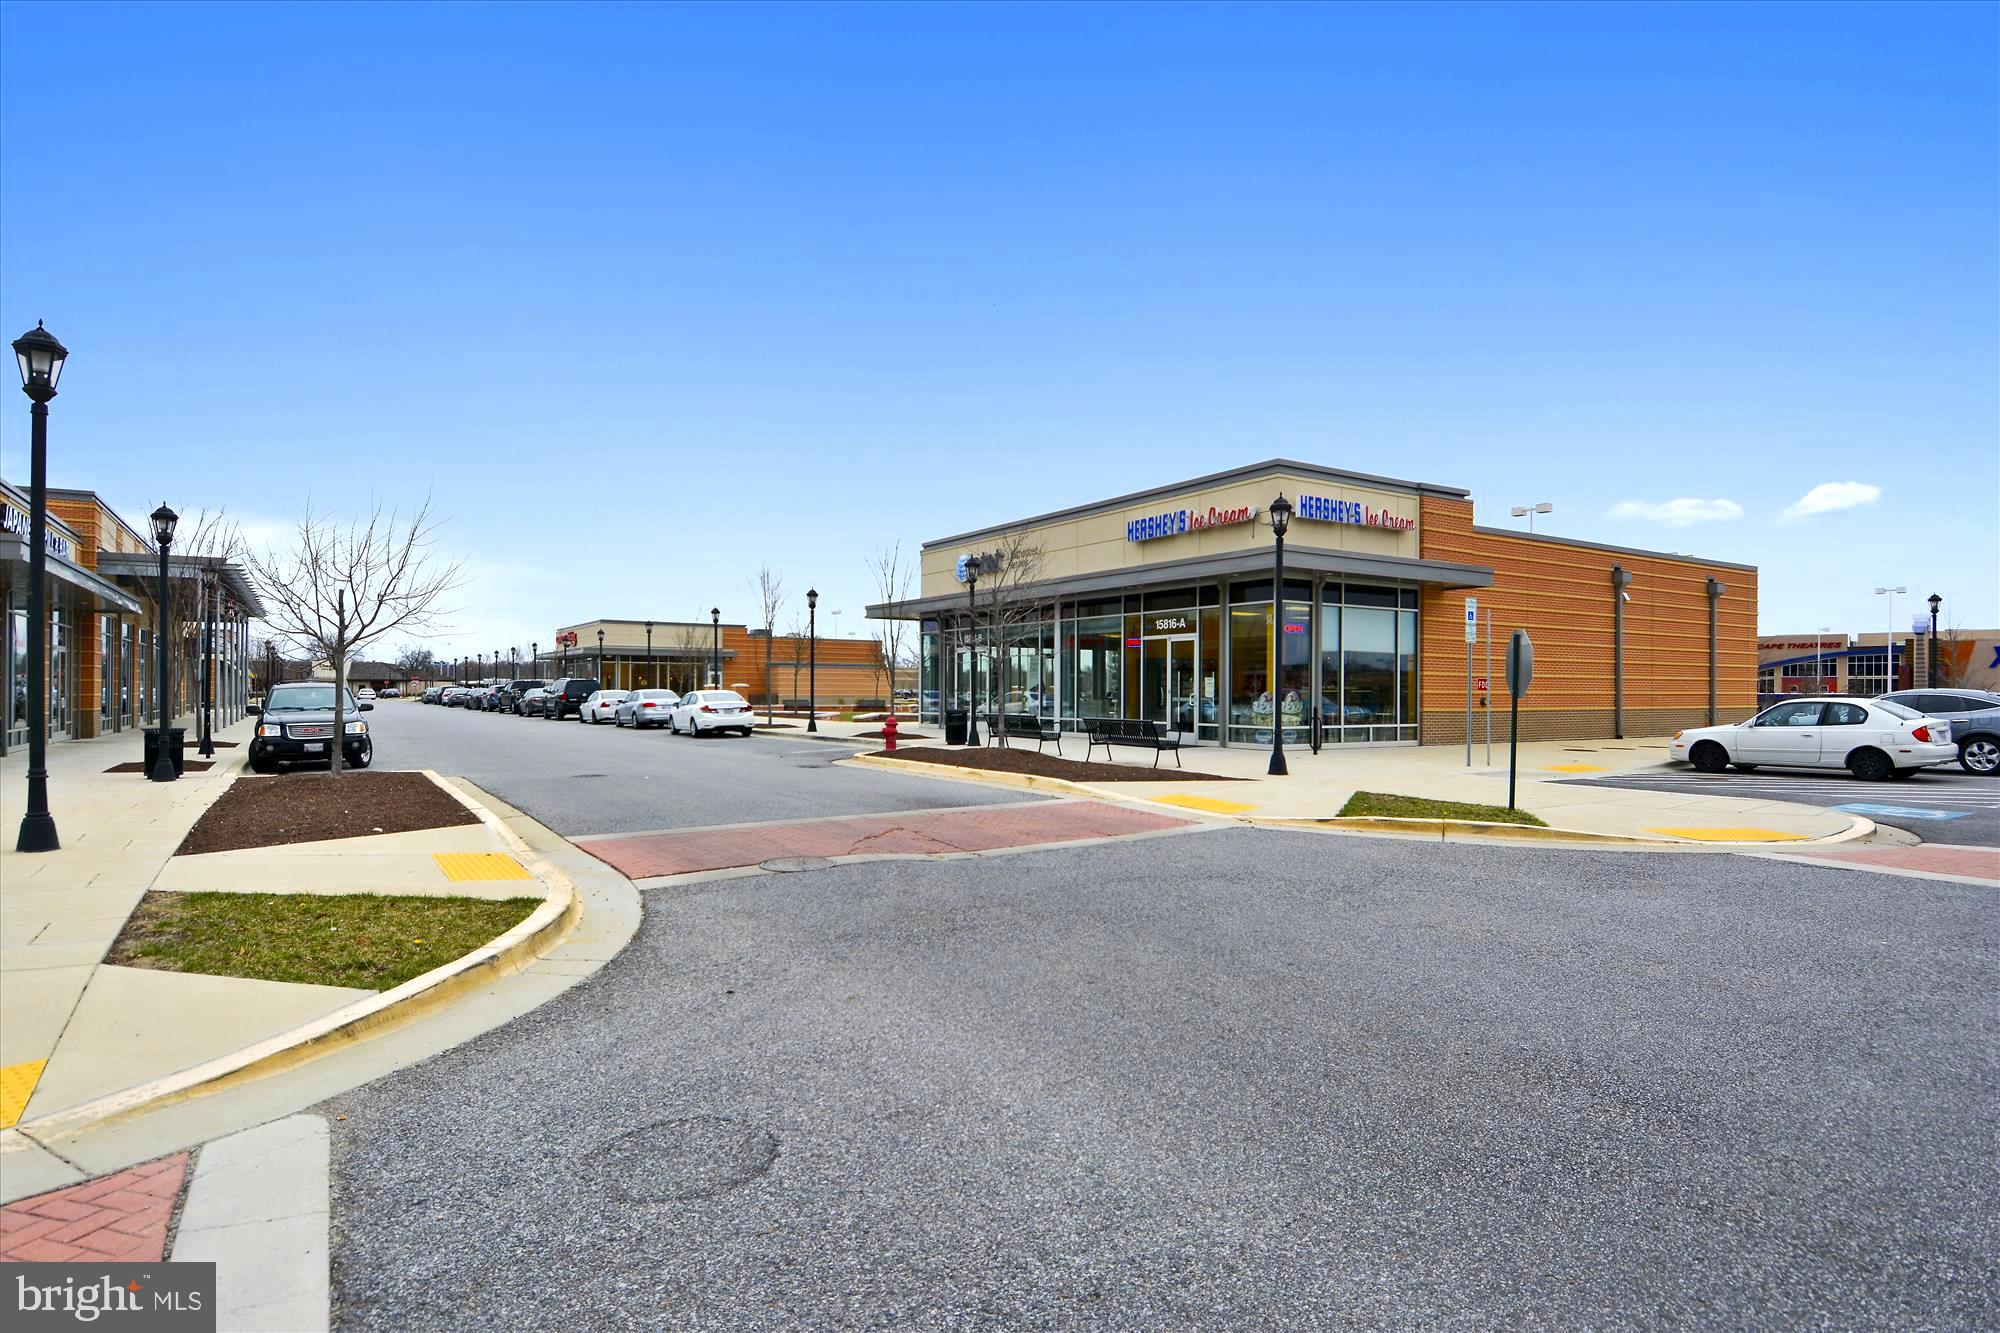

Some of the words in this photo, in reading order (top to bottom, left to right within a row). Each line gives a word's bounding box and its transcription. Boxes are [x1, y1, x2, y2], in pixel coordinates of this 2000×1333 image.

[3, 504, 31, 538] JAPANE
[1127, 510, 1186, 542] HERSHEY'S
[1190, 510, 1204, 529] Ice
[1208, 506, 1249, 528] Cream
[1300, 495, 1361, 525] HERSHEY'S
[1365, 506, 1379, 526] Ice
[1381, 509, 1415, 530] Cream
[1155, 618, 1186, 630] 15816-A
